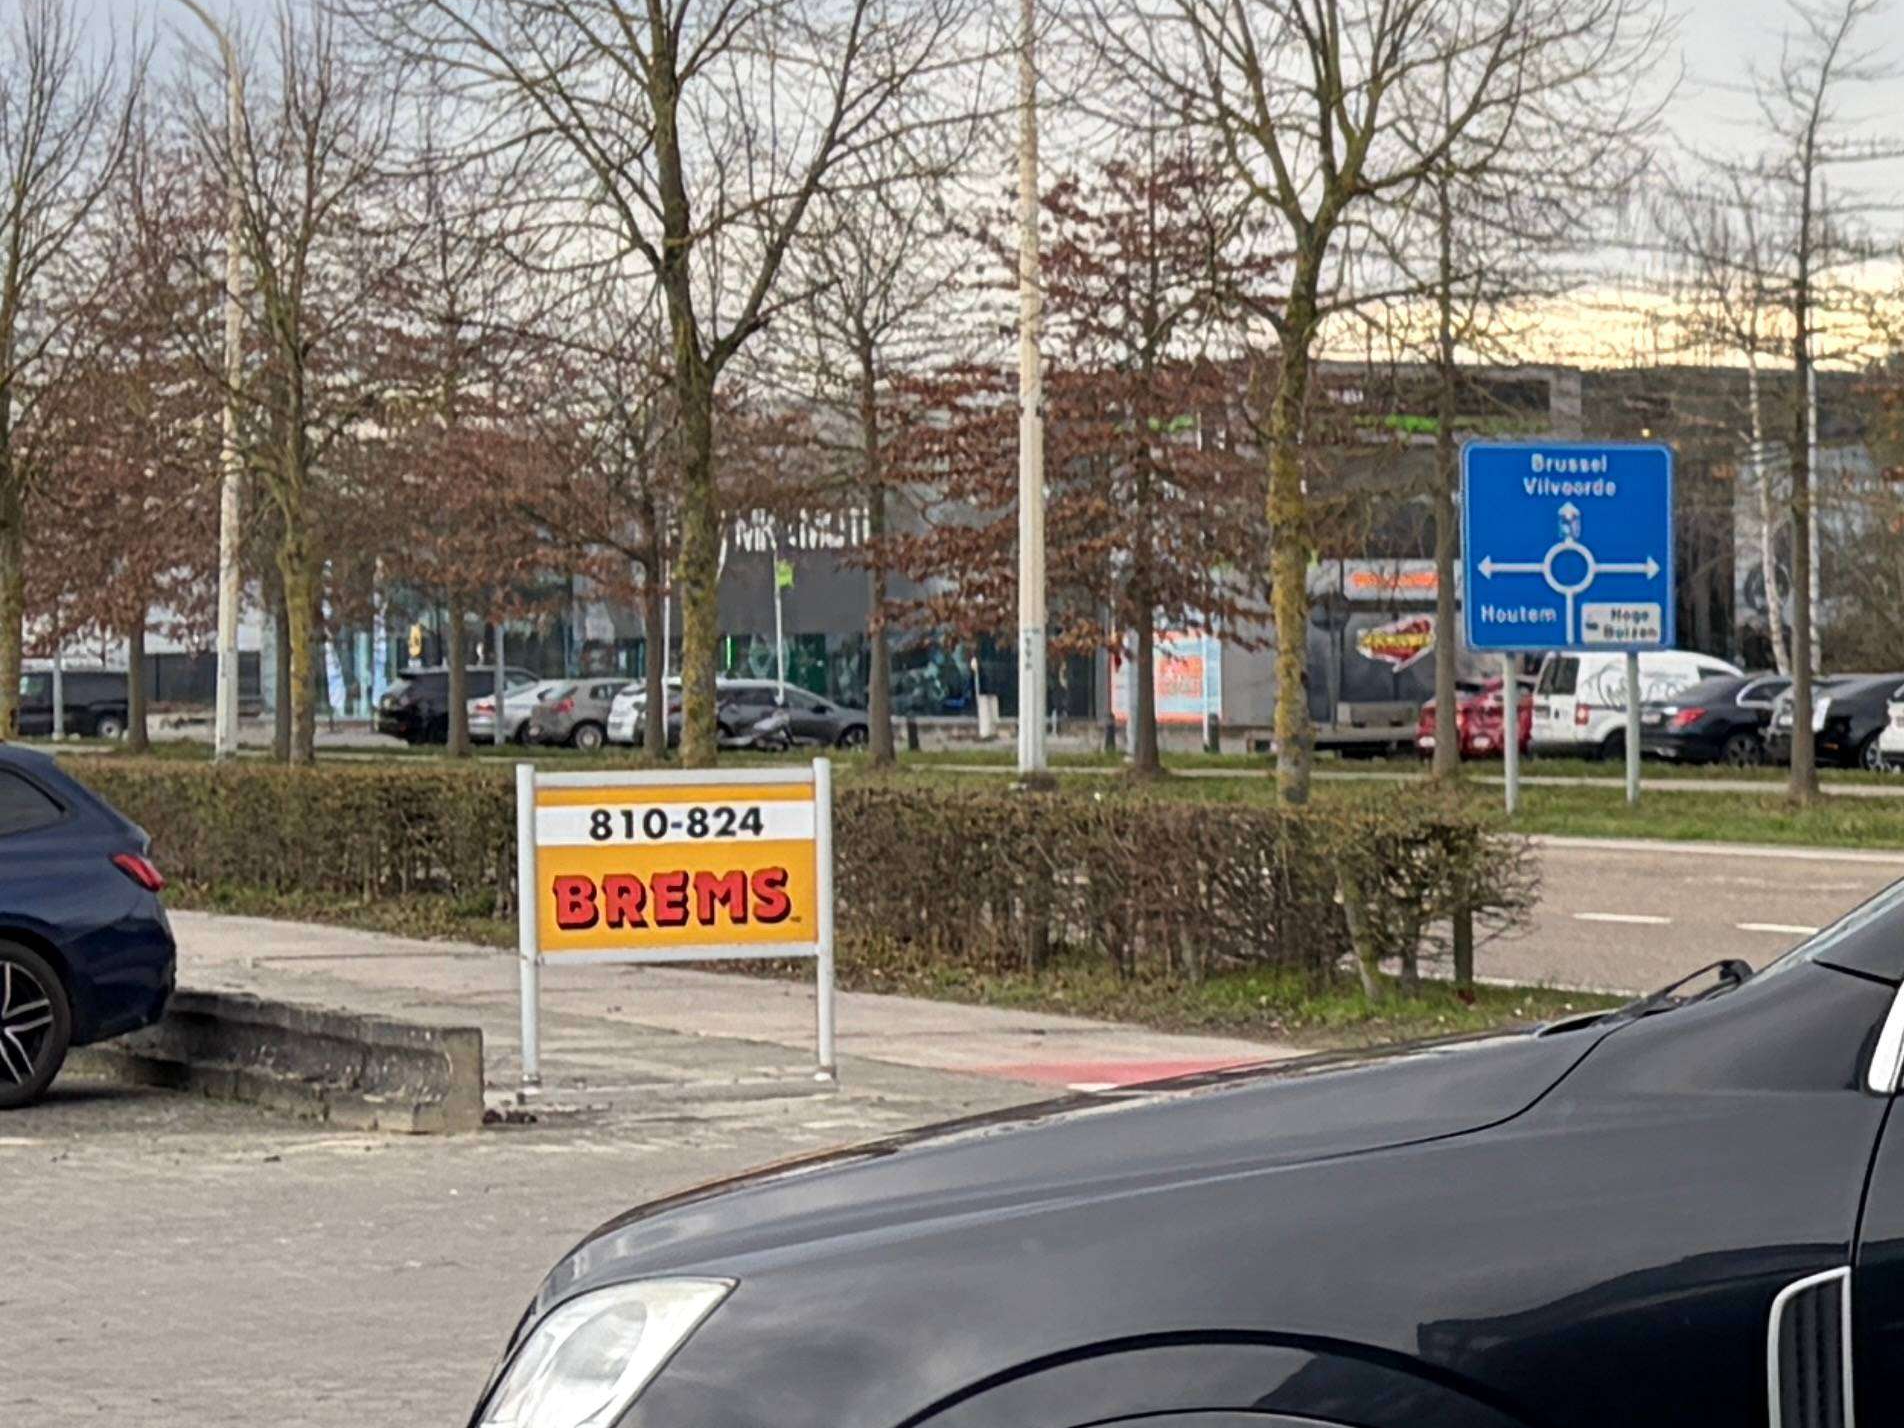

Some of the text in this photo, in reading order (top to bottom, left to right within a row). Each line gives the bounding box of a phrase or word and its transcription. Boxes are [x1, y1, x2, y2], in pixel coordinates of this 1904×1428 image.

[1531, 453, 1607, 473] Brussel
[1523, 476, 1617, 497] Vilvoorde
[1481, 604, 1558, 623] Houtem
[589, 805, 765, 841] 810-824
[552, 866, 792, 931] BREMS
